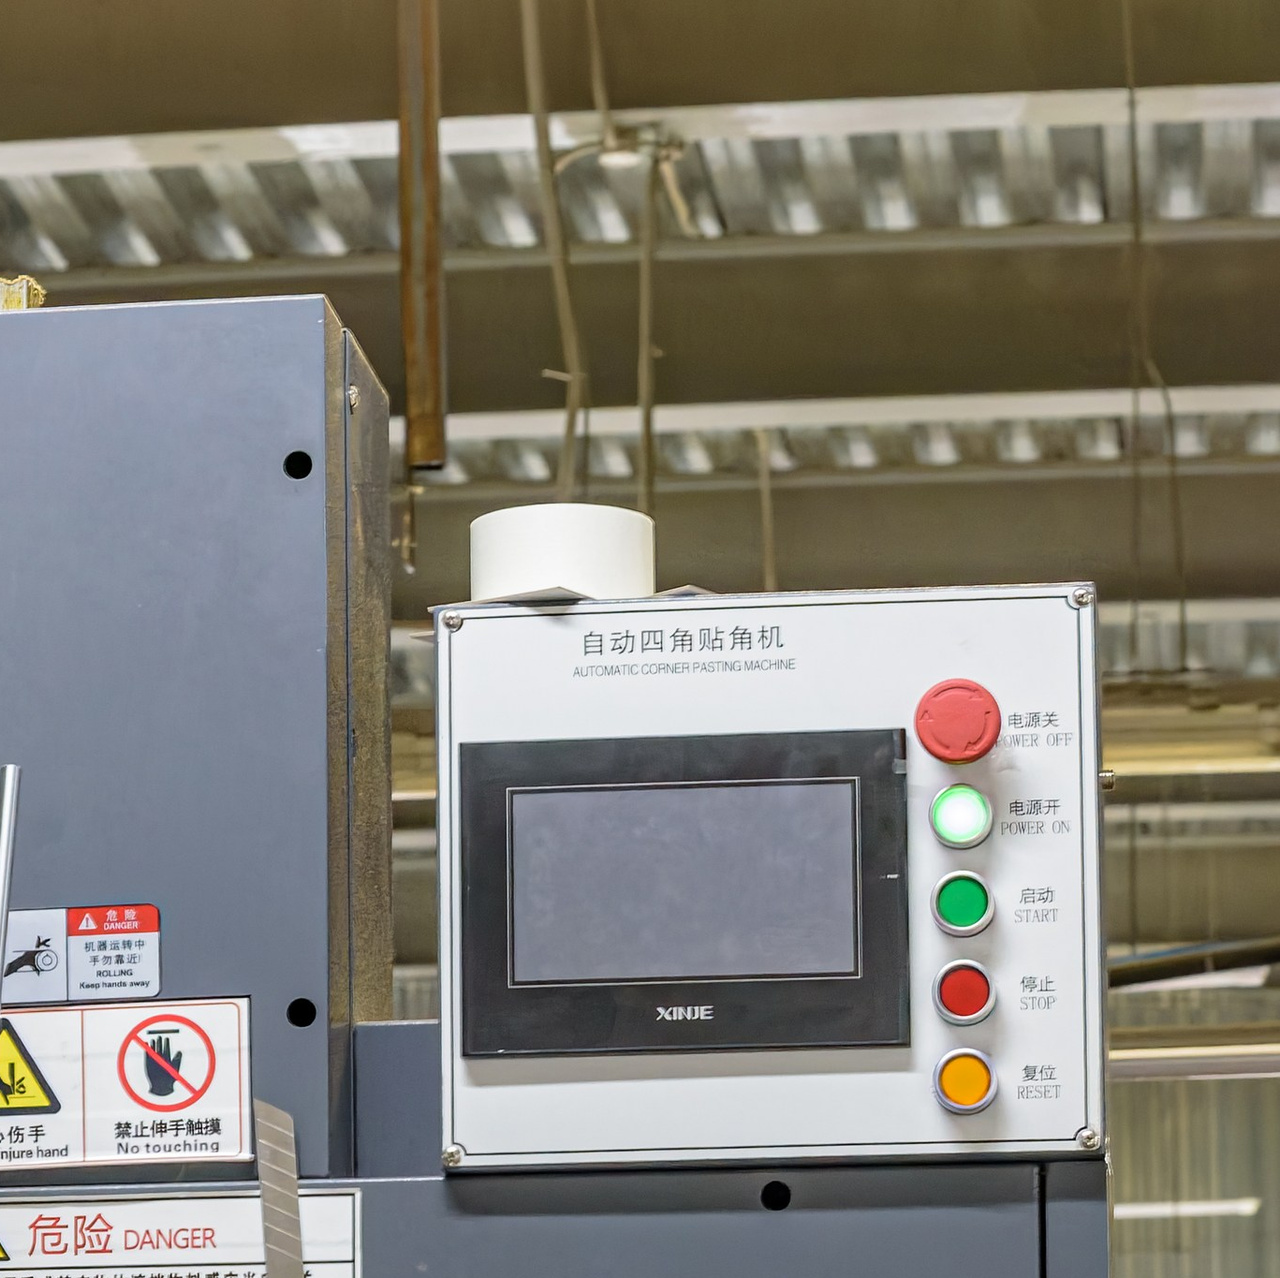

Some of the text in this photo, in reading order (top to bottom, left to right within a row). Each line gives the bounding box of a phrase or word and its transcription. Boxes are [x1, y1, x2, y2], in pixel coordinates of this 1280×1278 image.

[582, 625, 785, 656] 自动四角贴角机
[573, 658, 797, 678] AUTOMATIC CORNER PASTING MACHINE
[1008, 711, 1059, 729] 电源关
[995, 732, 1073, 748] POWER OFF
[1009, 799, 1060, 816] 电源开
[1000, 820, 1071, 836] POWER ON
[1019, 887, 1055, 904] 启动
[106, 909, 136, 922] 危险
[1014, 908, 1058, 924] START
[103, 921, 138, 931] DANGER
[84, 939, 144, 953] 机器运转中
[96, 968, 133, 978] ROLLING
[79, 980, 150, 991] Keep hands away
[1020, 975, 1057, 993] 停止
[1020, 995, 1056, 1011] STOP
[656, 1005, 715, 1021] XINJE
[1021, 1064, 1057, 1082] 复位
[1017, 1084, 1061, 1100] RESET
[114, 1118, 222, 1139] 禁止伸手触摸
[36, 1145, 69, 1158] hand
[117, 1139, 220, 1155] No touching
[28, 1213, 217, 1257] 危险 DANGER
